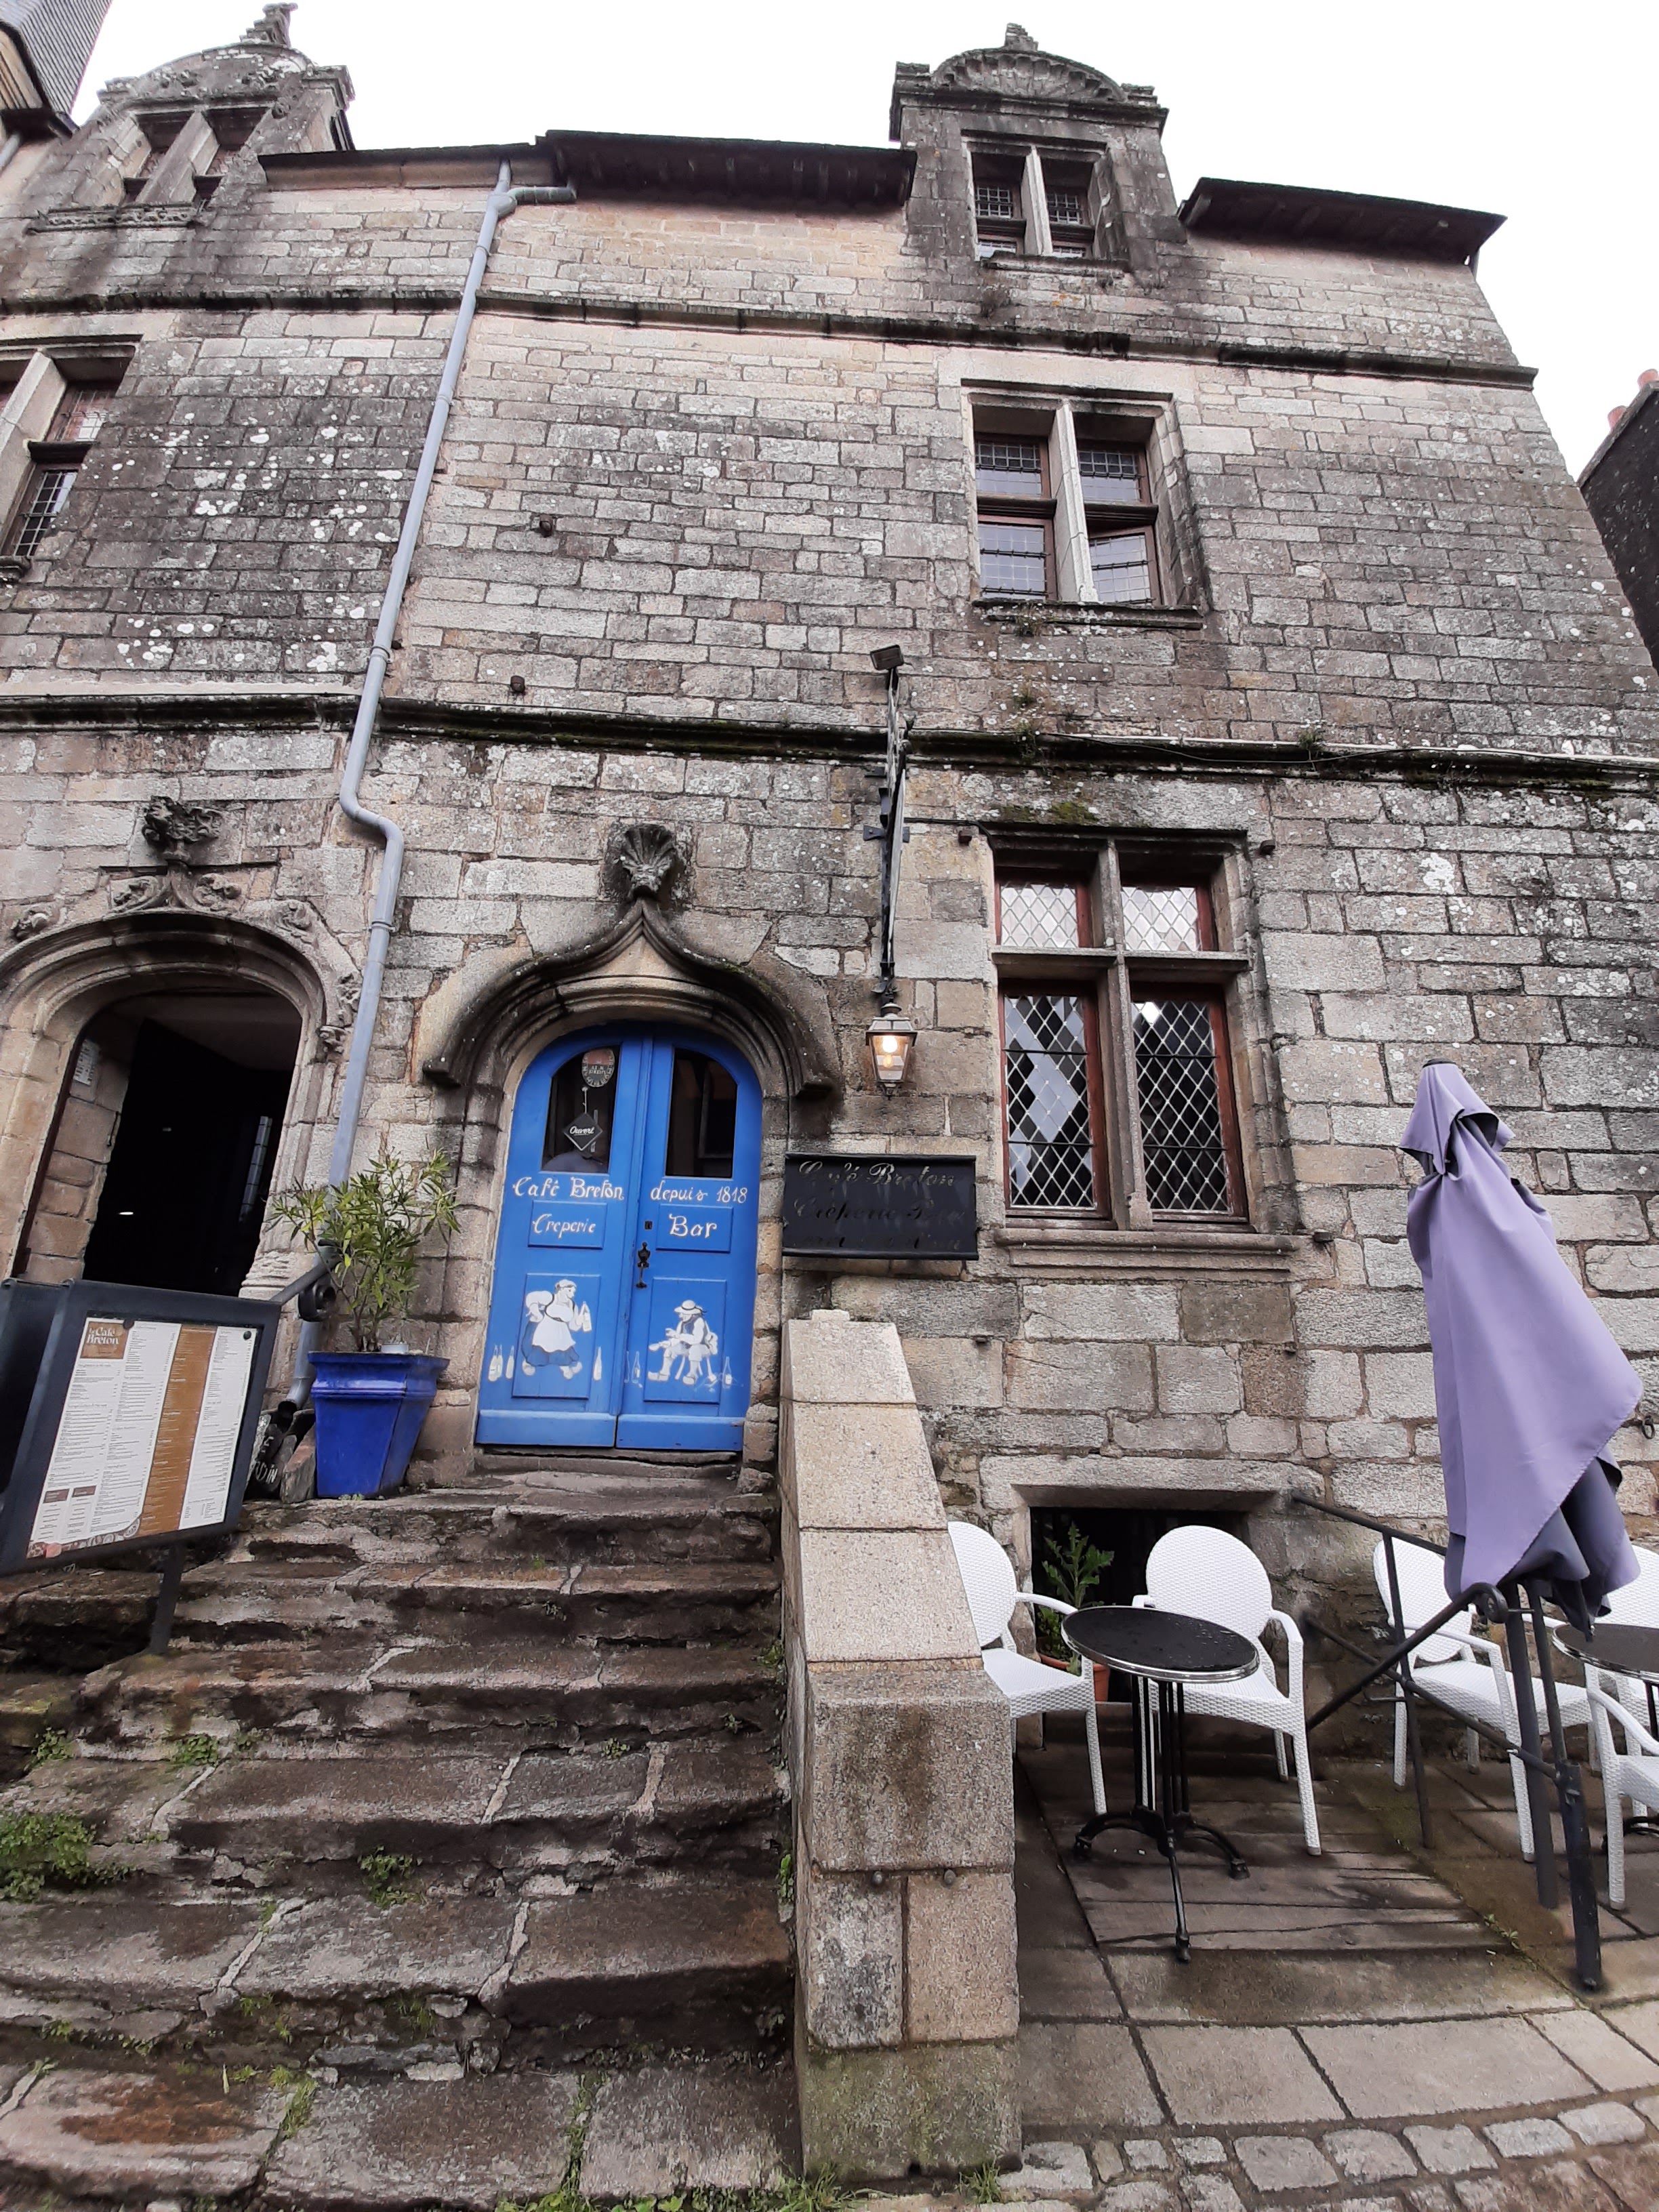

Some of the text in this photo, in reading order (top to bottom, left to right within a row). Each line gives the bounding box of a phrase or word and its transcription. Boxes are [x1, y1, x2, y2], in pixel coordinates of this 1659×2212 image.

[569, 1126, 595, 1134] Ouvert
[869, 1162, 955, 1186] Breton
[512, 1176, 624, 1200] Café Breton
[651, 1180, 747, 1204] depuis 1818
[668, 1213, 717, 1238] Bar
[87, 1335, 119, 1345] Breton
